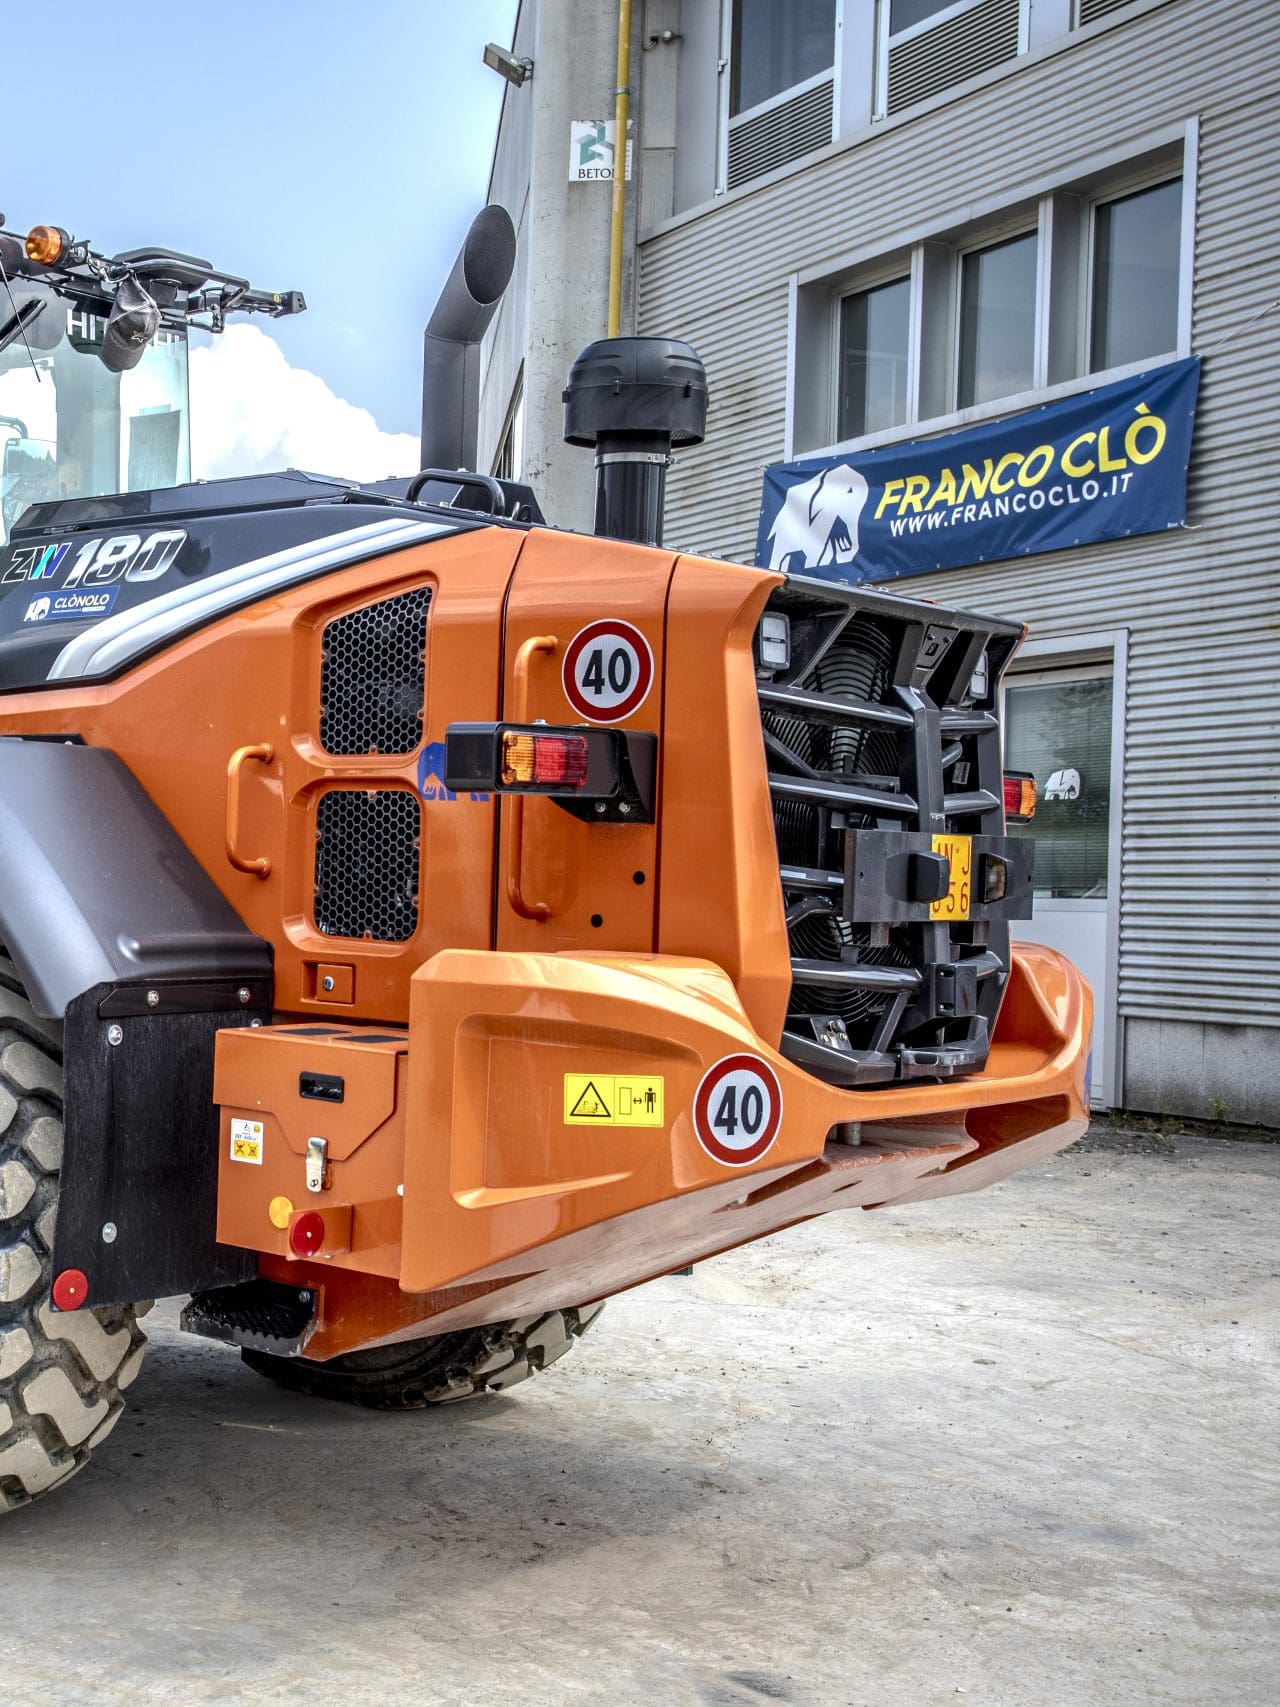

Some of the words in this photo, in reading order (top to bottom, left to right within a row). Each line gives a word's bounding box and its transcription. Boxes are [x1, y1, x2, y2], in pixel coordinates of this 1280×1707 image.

[873, 444, 1055, 520] FRANCO
[1061, 402, 1167, 478] CLÒ
[890, 472, 1134, 537] WWW.FRANCOCLO.IT
[1, 542, 72, 584] ZW
[61, 529, 188, 589] 180
[54, 593, 110, 609] CLÒNOLO
[581, 647, 632, 695] 40
[713, 1085, 764, 1136] 40
